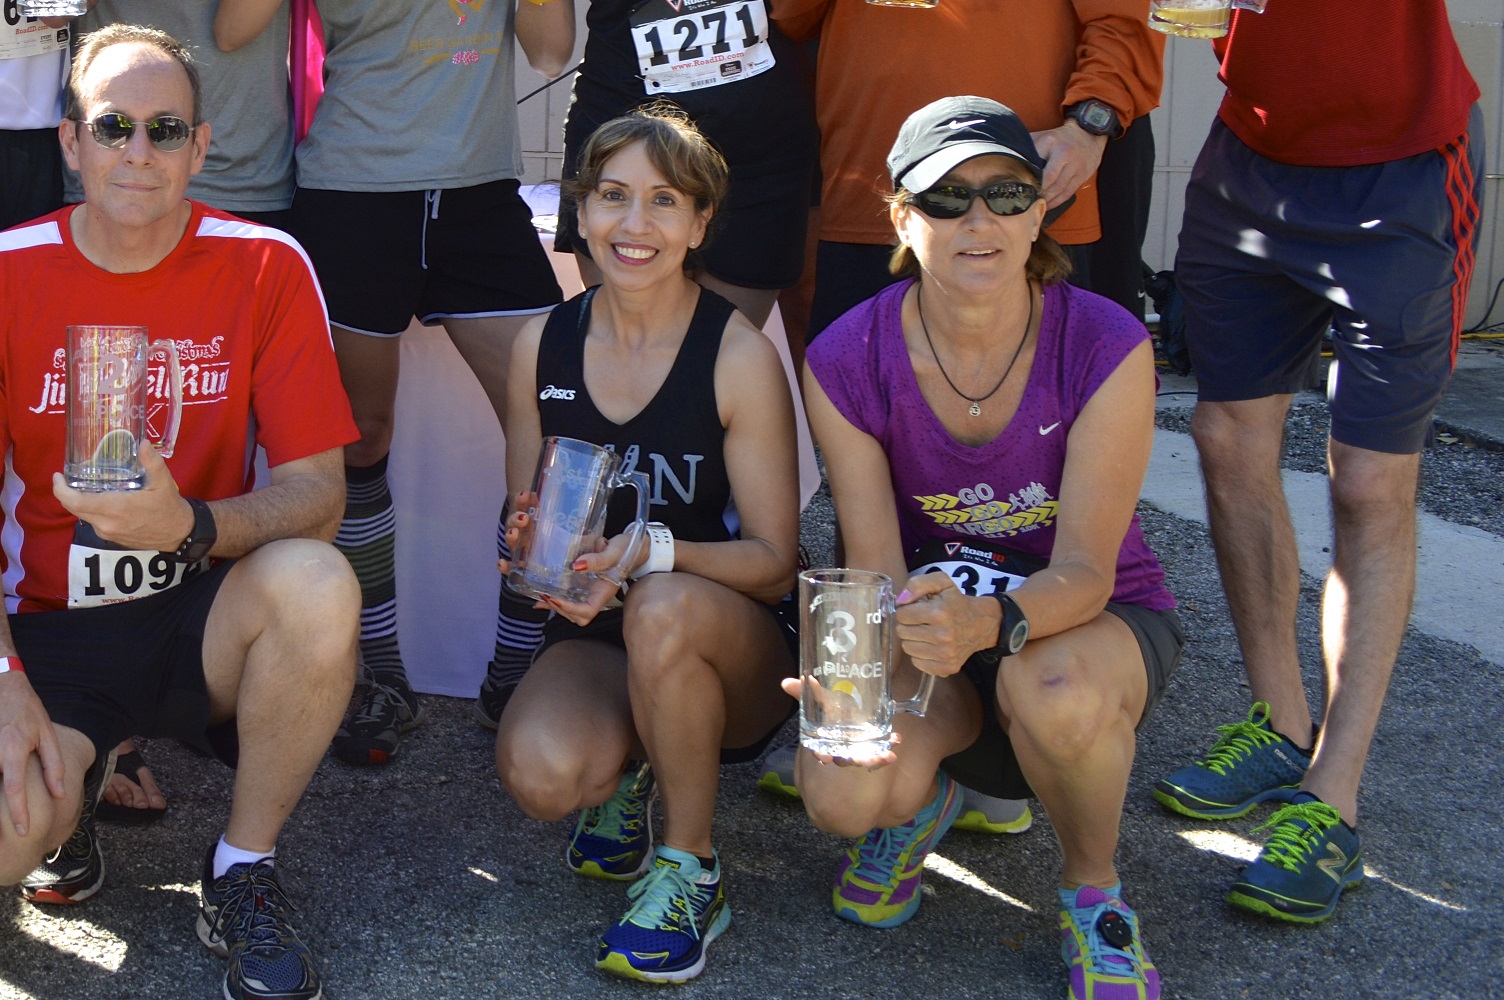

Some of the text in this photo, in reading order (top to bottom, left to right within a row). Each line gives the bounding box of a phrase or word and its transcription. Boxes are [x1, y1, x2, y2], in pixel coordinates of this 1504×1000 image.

[644, 4, 760, 67] 1271
[670, 51, 745, 71] www.RoadID.com
[959, 483, 995, 506] GO
[971, 501, 1004, 520] GO
[939, 516, 1014, 536] FARGO
[960, 546, 1006, 563] RoadID
[826, 609, 882, 654] 3 rd
[823, 661, 882, 679] PLACE
